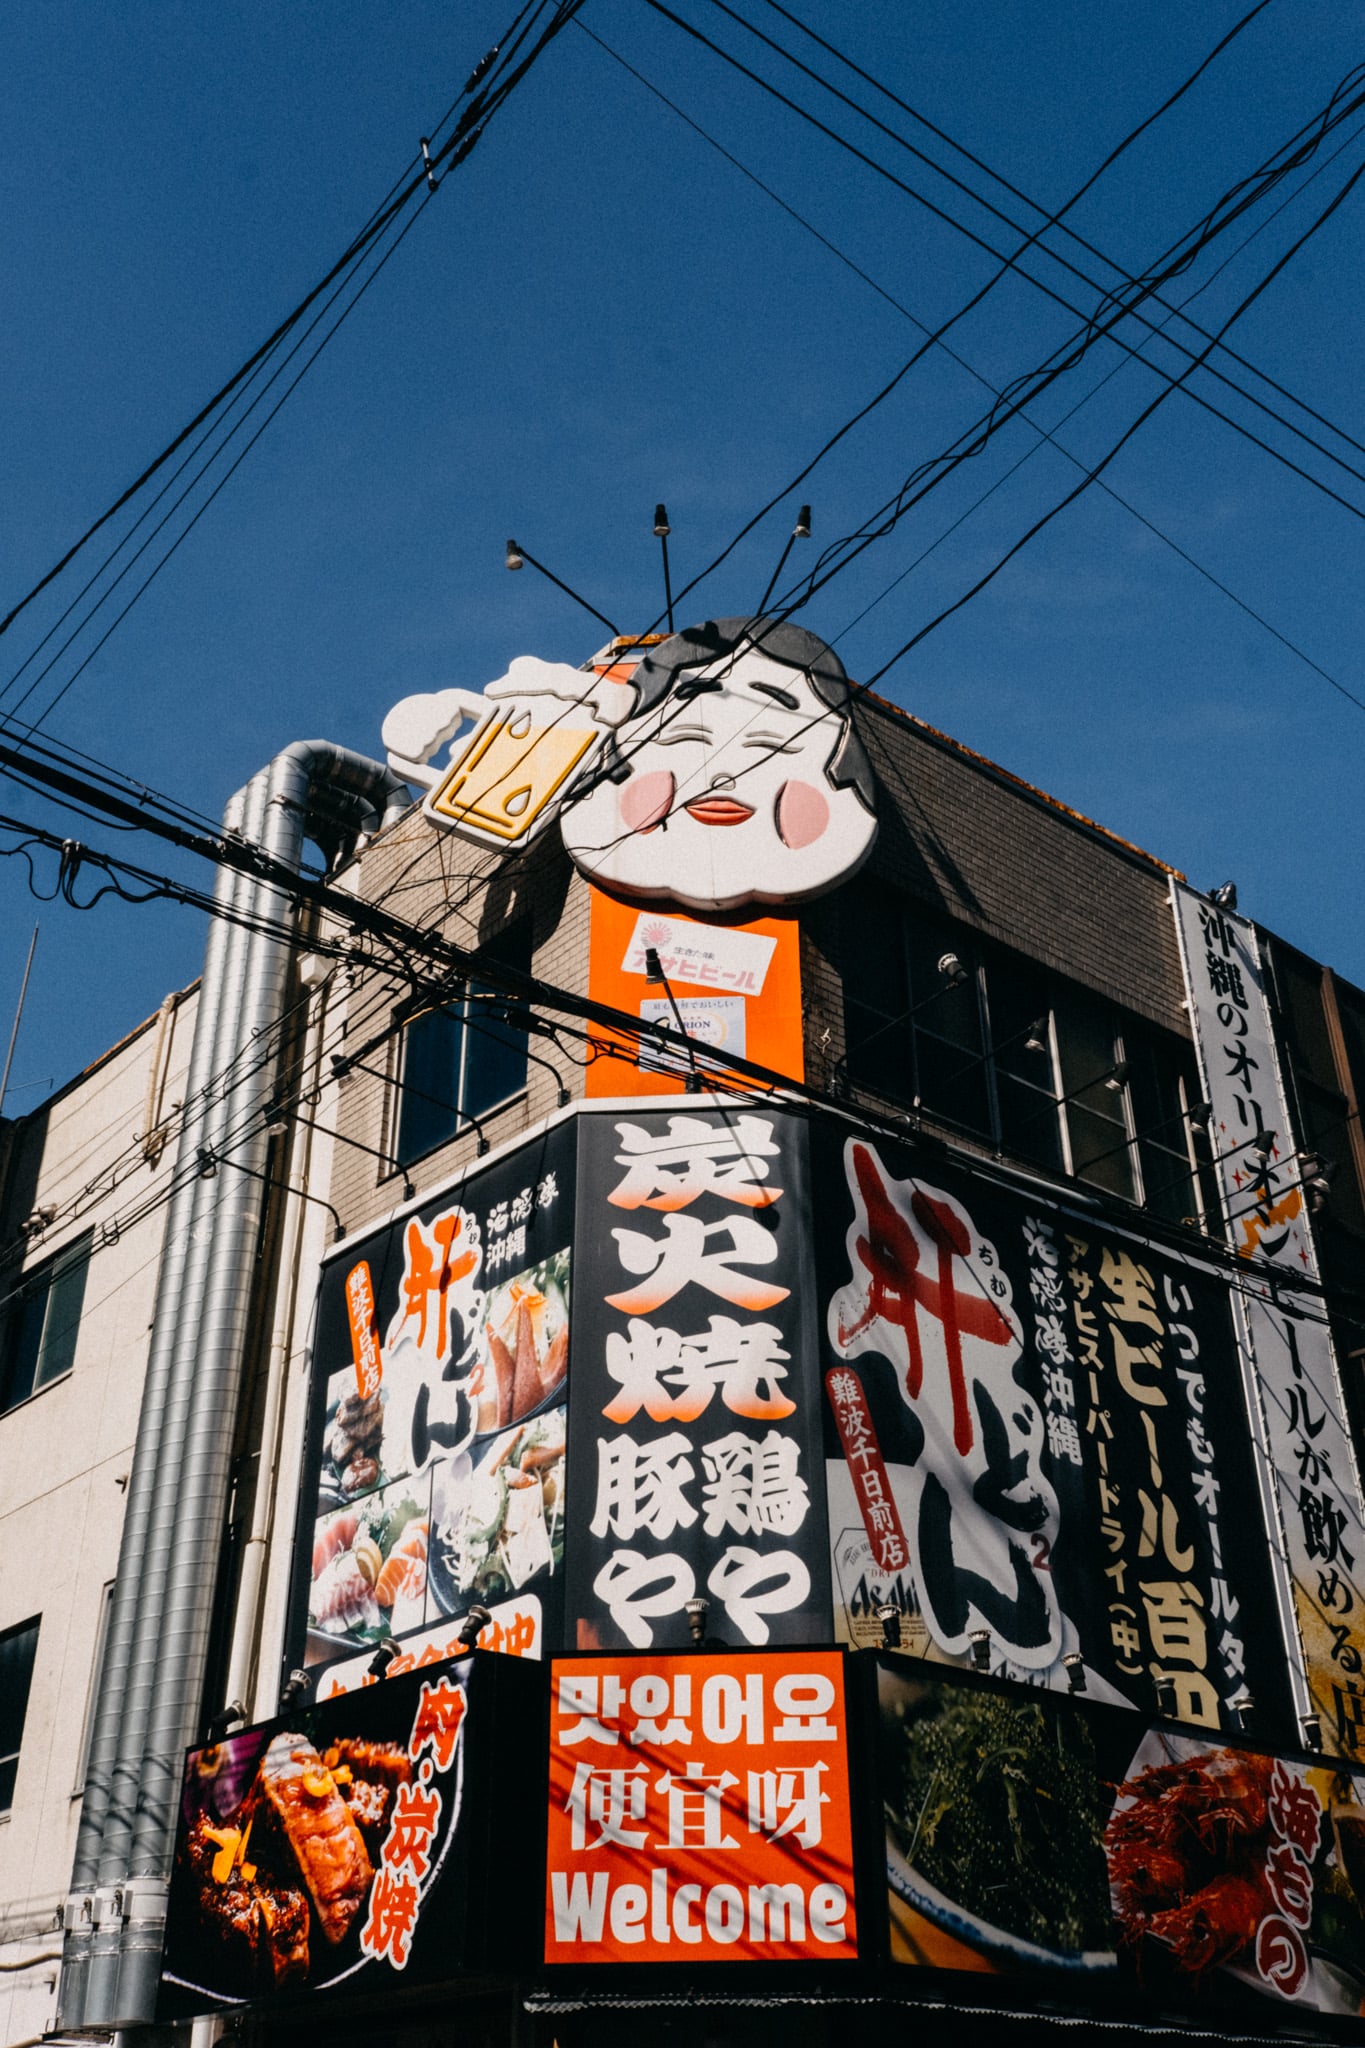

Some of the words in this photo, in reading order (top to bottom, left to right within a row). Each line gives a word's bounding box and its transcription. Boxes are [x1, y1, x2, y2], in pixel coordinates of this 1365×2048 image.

[485, 1224, 526, 1273] 沖縄
[602, 1116, 797, 1424] 炭火焼
[978, 1245, 1007, 1297] ちむ
[349, 1268, 380, 1395] 難波千日前店
[468, 1364, 485, 1398] 2
[830, 1372, 904, 1567] 難波千日前店
[1100, 1246, 1222, 1730] 生ビール百円
[589, 1433, 697, 1648] 豚や
[702, 1430, 810, 1646] 鶏や
[1031, 1534, 1051, 1571] 2
[557, 1673, 838, 1745] 맛있어요
[564, 1760, 830, 1850] 便宜呀
[551, 1868, 847, 1944] Welcome
